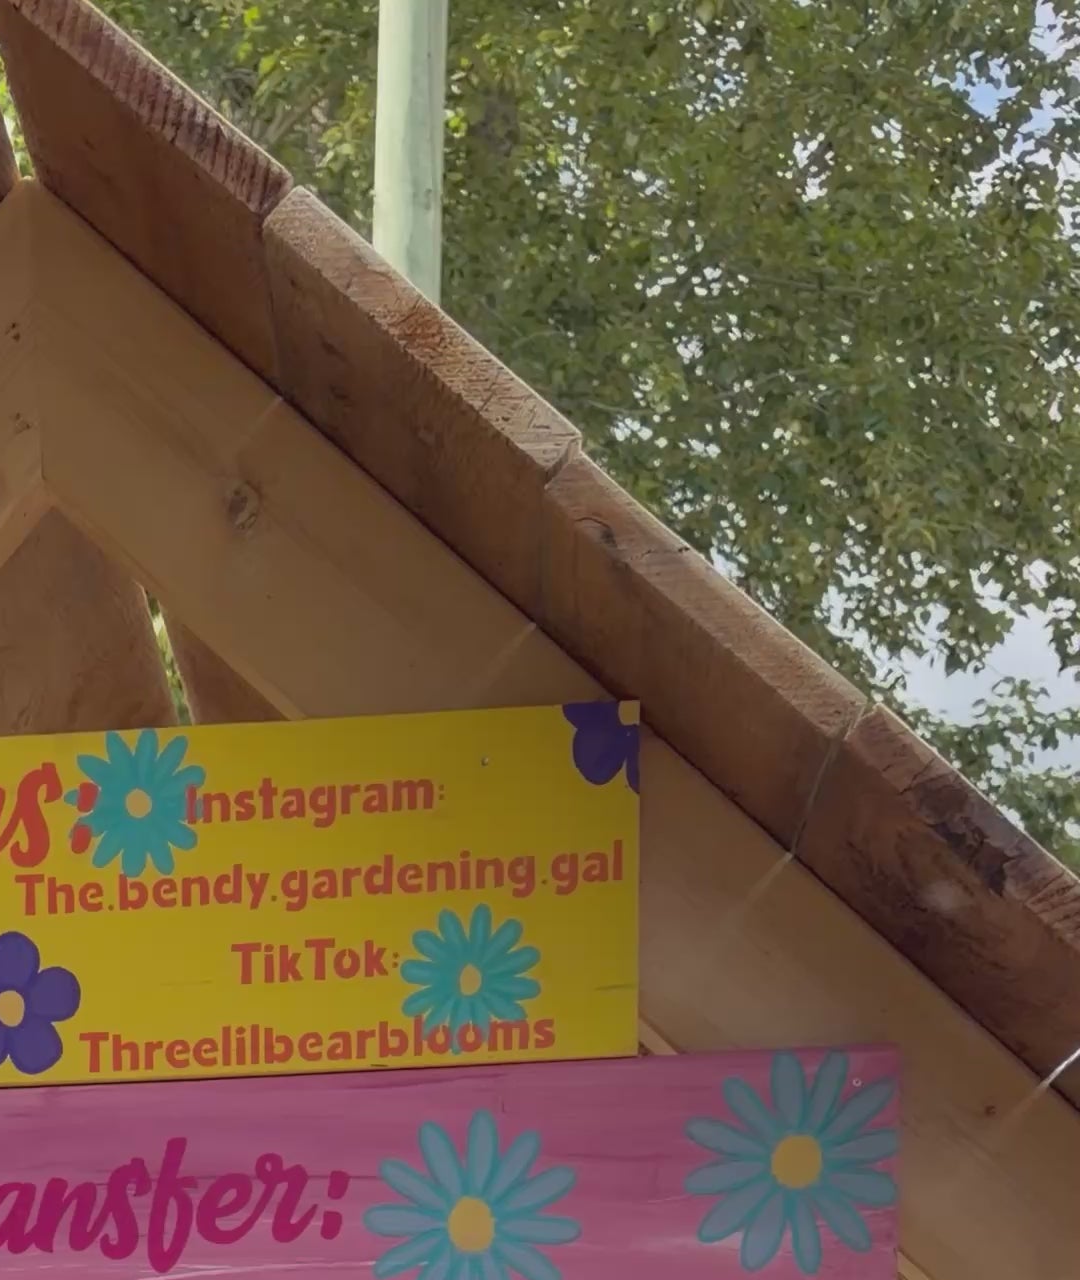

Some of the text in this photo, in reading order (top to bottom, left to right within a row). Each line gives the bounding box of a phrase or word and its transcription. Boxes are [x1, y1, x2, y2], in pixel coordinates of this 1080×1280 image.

[185, 776, 445, 829] Instagram:
[14, 840, 625, 916] The.bendy.gardening.gal
[230, 937, 401, 986] TikTok:
[79, 1015, 556, 1073] Threelilbearblooms
